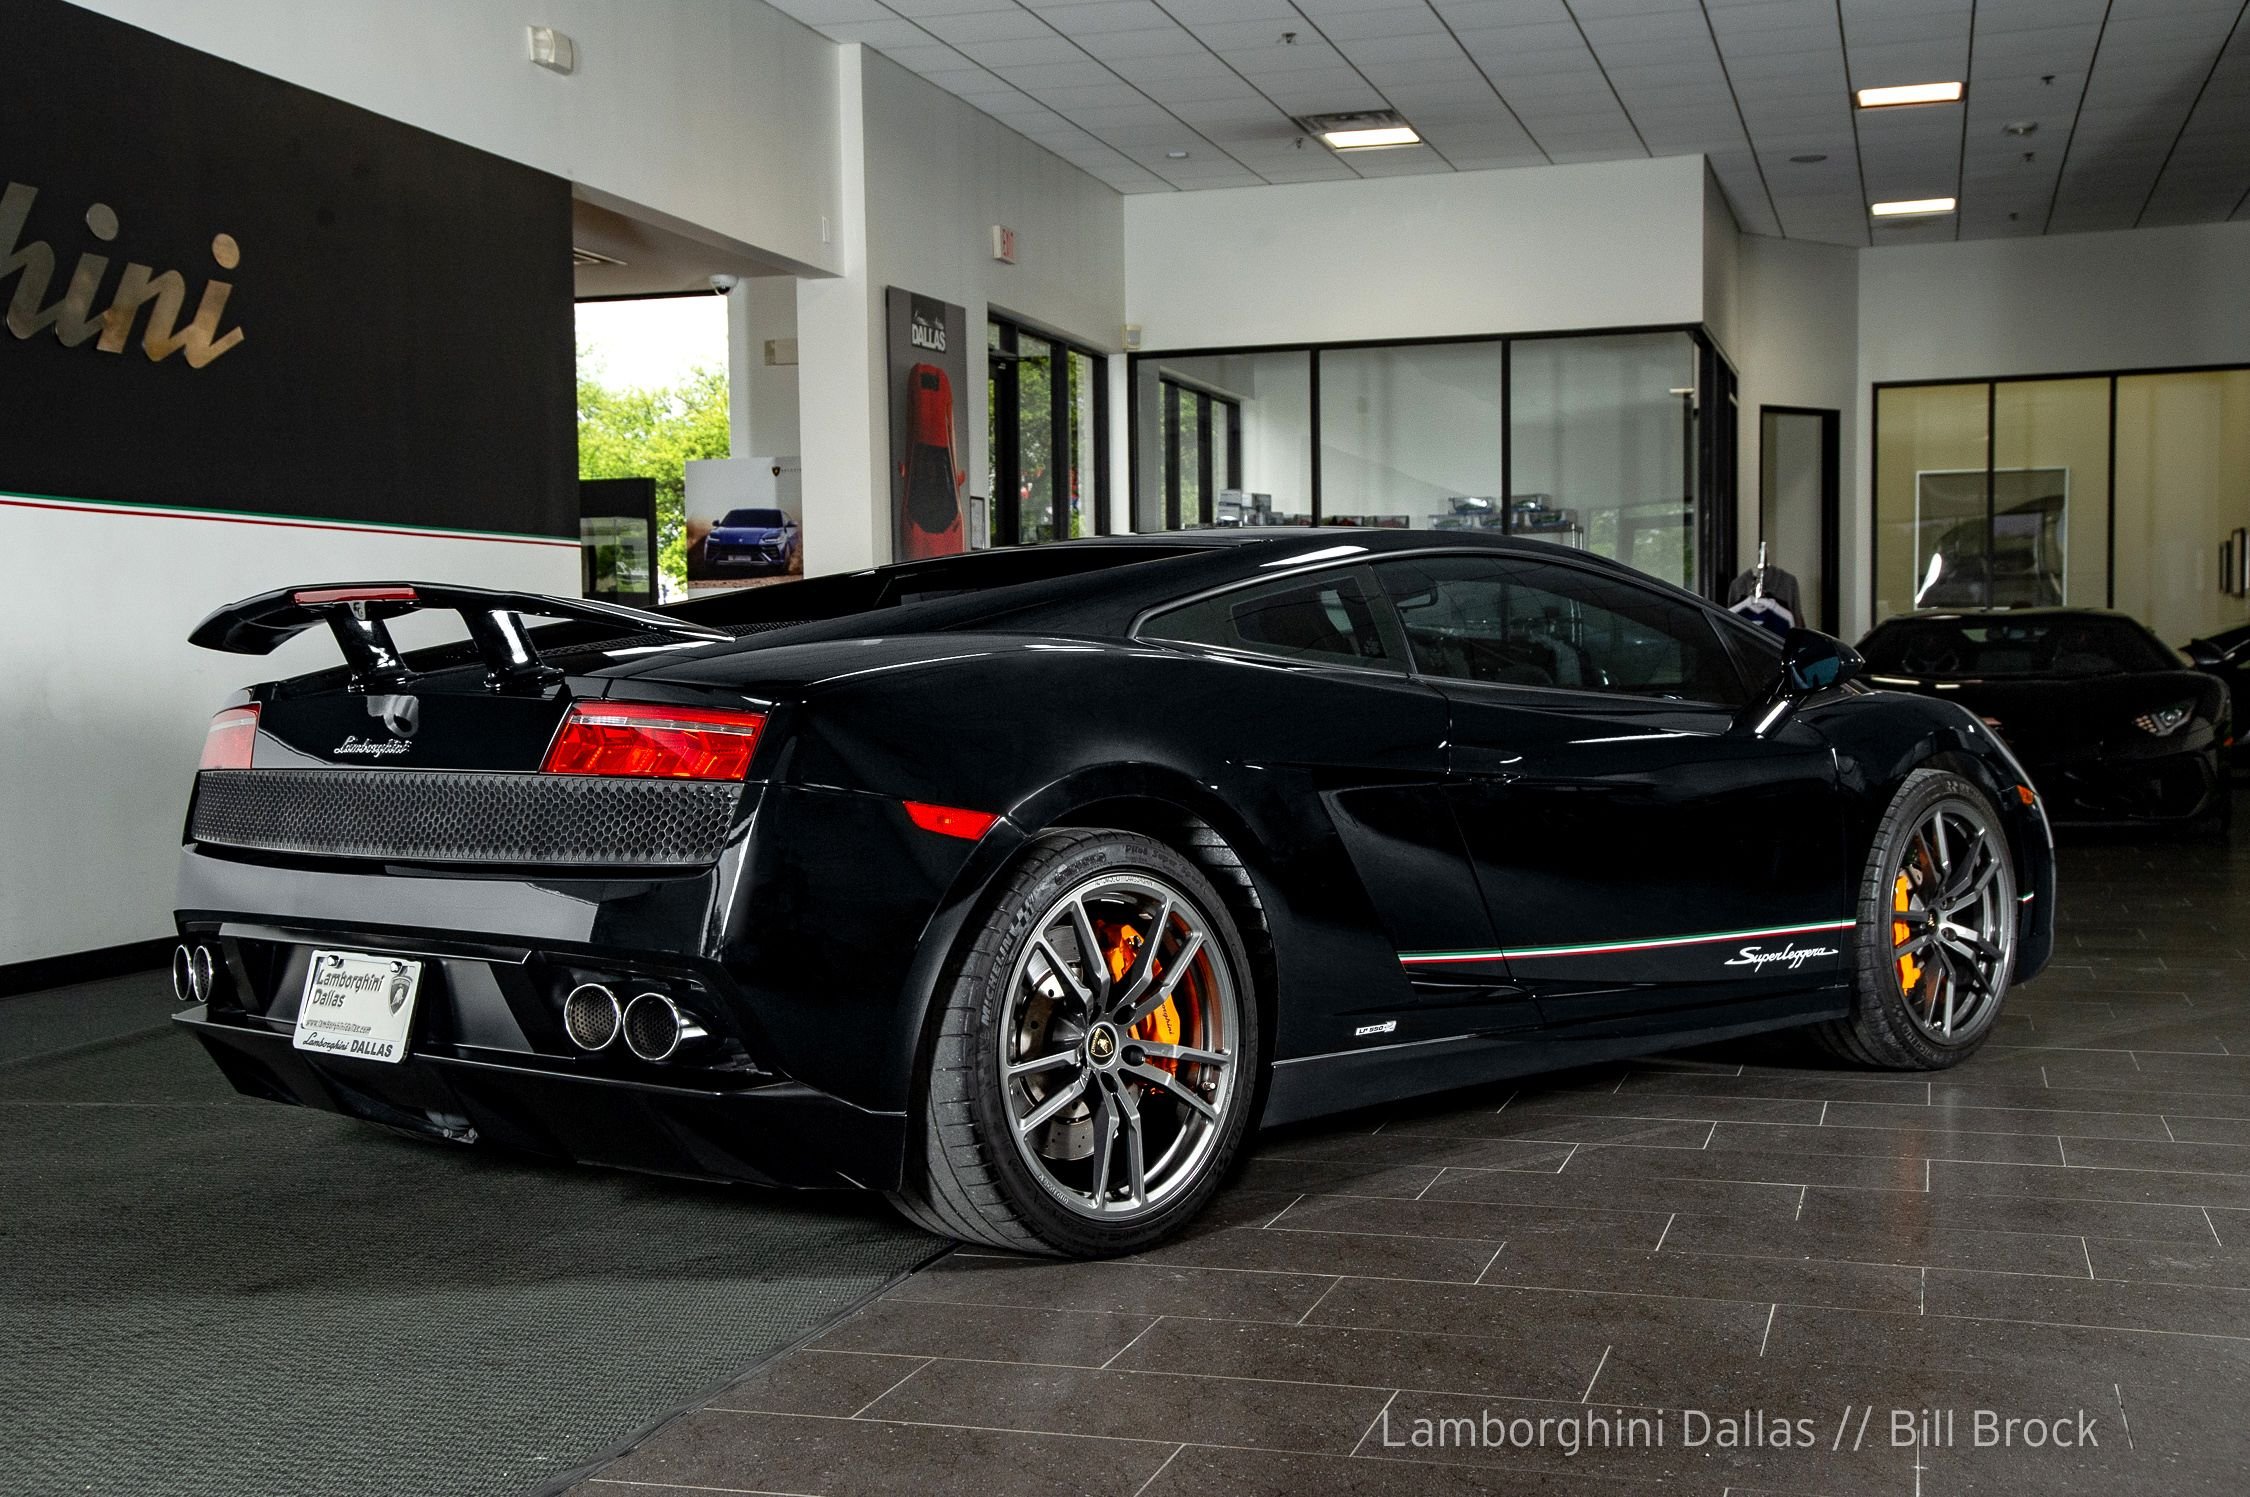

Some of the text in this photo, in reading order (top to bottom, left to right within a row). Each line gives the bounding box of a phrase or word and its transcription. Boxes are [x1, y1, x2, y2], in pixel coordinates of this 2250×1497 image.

[911, 323, 946, 352] DALLAS
[333, 736, 412, 758] Lamborghini
[1724, 942, 1839, 973] Superleggera
[316, 968, 385, 993] Lamborghini
[980, 931, 1017, 1027] MICHELIN
[312, 989, 346, 1008] Dallas
[303, 1032, 393, 1058] Lamborghini DALLAS
